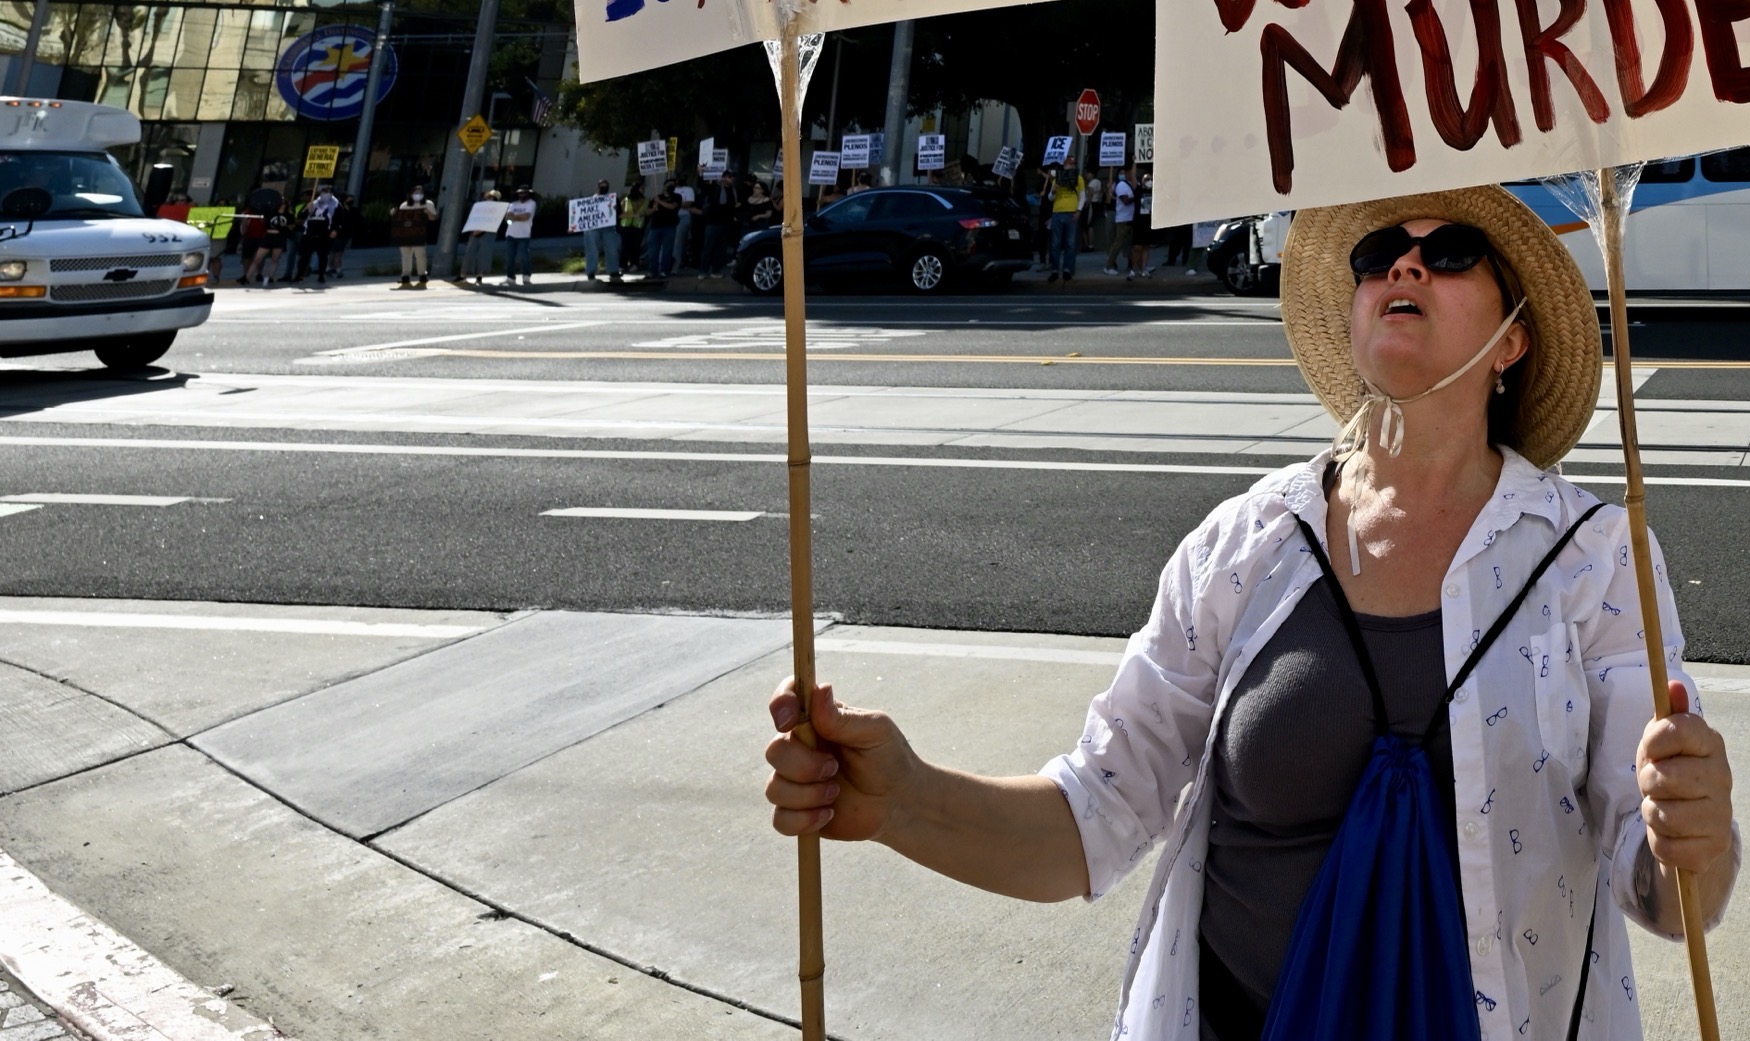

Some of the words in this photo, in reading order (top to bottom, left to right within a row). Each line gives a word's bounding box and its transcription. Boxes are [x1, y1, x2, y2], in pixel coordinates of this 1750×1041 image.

[1078, 104, 1099, 120] STOP
[1050, 138, 1067, 150] ICE
[580, 205, 598, 214] MAKE
